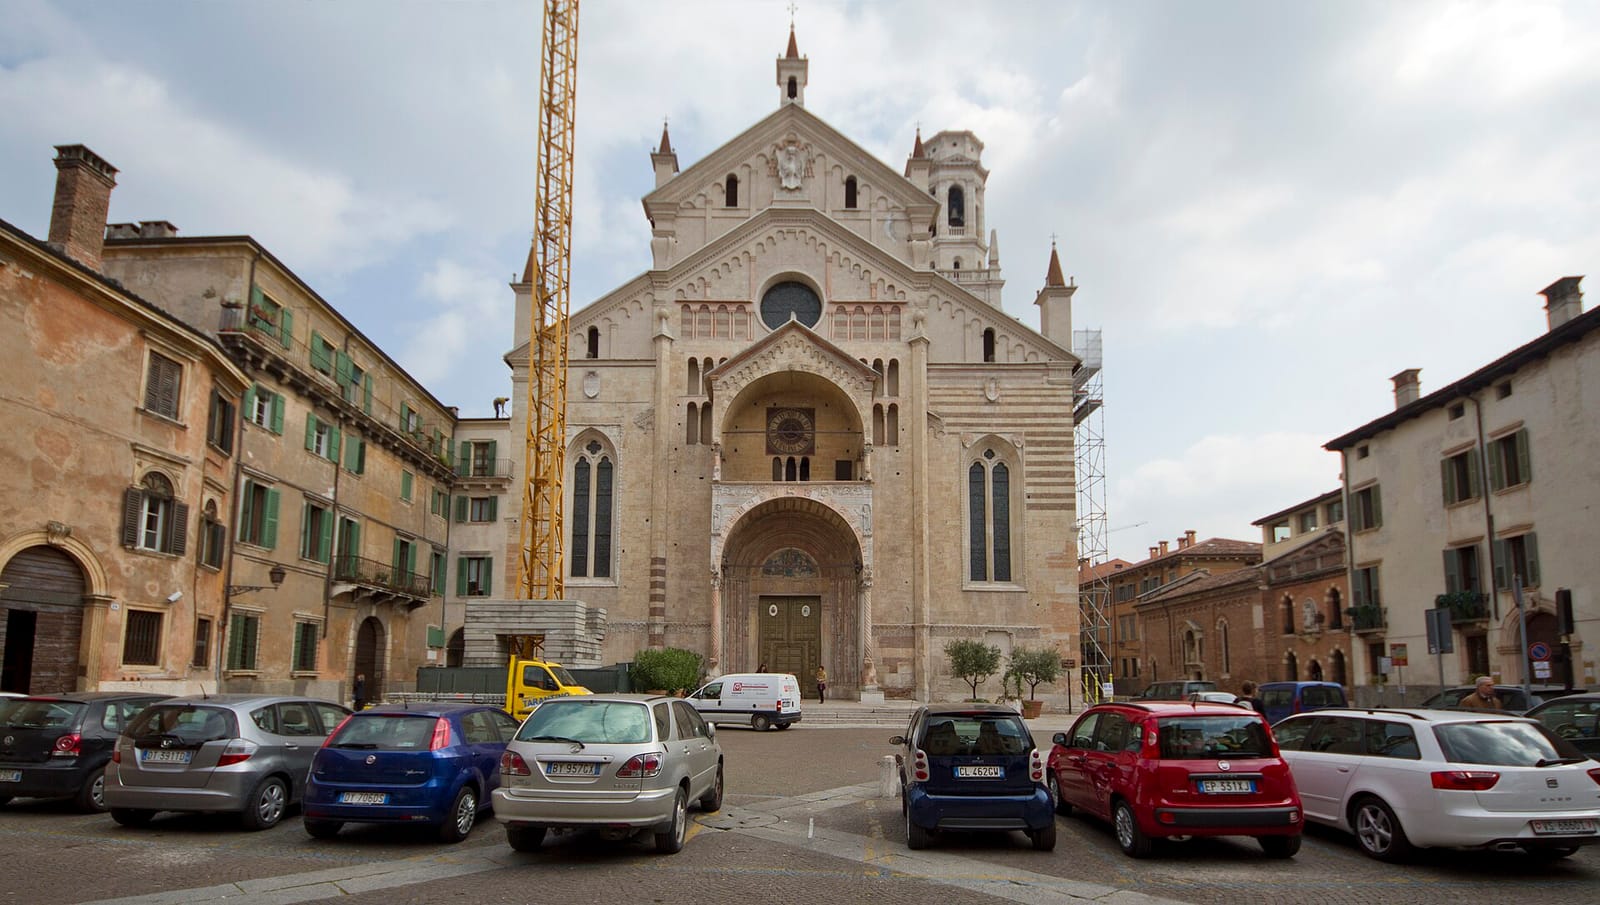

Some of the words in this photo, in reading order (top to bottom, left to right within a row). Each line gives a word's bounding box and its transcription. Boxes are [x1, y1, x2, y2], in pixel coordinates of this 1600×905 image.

[552, 763, 563, 773] BY
[566, 763, 594, 773] 957GX
[959, 767, 970, 776] CL
[972, 767, 999, 776] 462GW
[1205, 781, 1216, 791] EP
